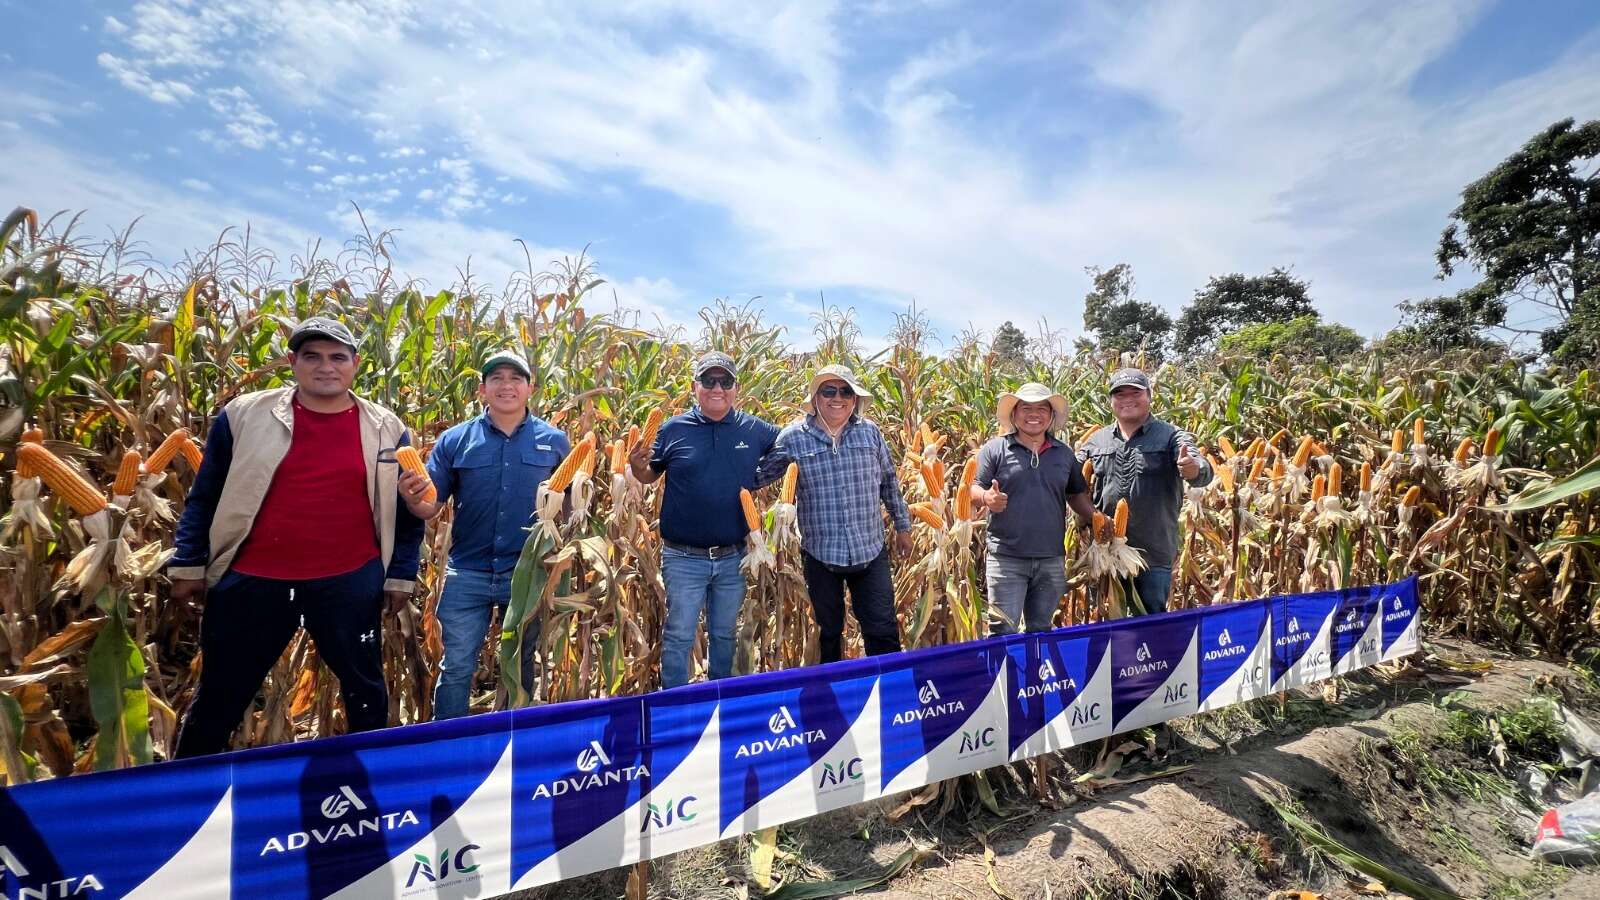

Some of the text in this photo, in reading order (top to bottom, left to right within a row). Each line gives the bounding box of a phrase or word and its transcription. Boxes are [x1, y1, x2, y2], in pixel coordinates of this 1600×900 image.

[1335, 620, 1365, 633] ADVANTA
[1386, 609, 1411, 622] ADVANTA
[1275, 632, 1311, 647] ADVANTA
[1204, 645, 1246, 661] ADVANTA
[1119, 660, 1168, 679] ADVANTA
[1017, 678, 1076, 699] ADVANTA
[1164, 682, 1188, 704] AIC
[892, 700, 965, 726] ADVANTA
[1071, 702, 1100, 726] AIC
[735, 729, 827, 759] ADVANTA
[959, 727, 994, 754] AIC
[532, 764, 651, 800] ADVANTA
[819, 758, 863, 788] AIC
[640, 796, 698, 832] AIC
[259, 808, 420, 857] ADVANTA
[405, 844, 481, 888] AIC
